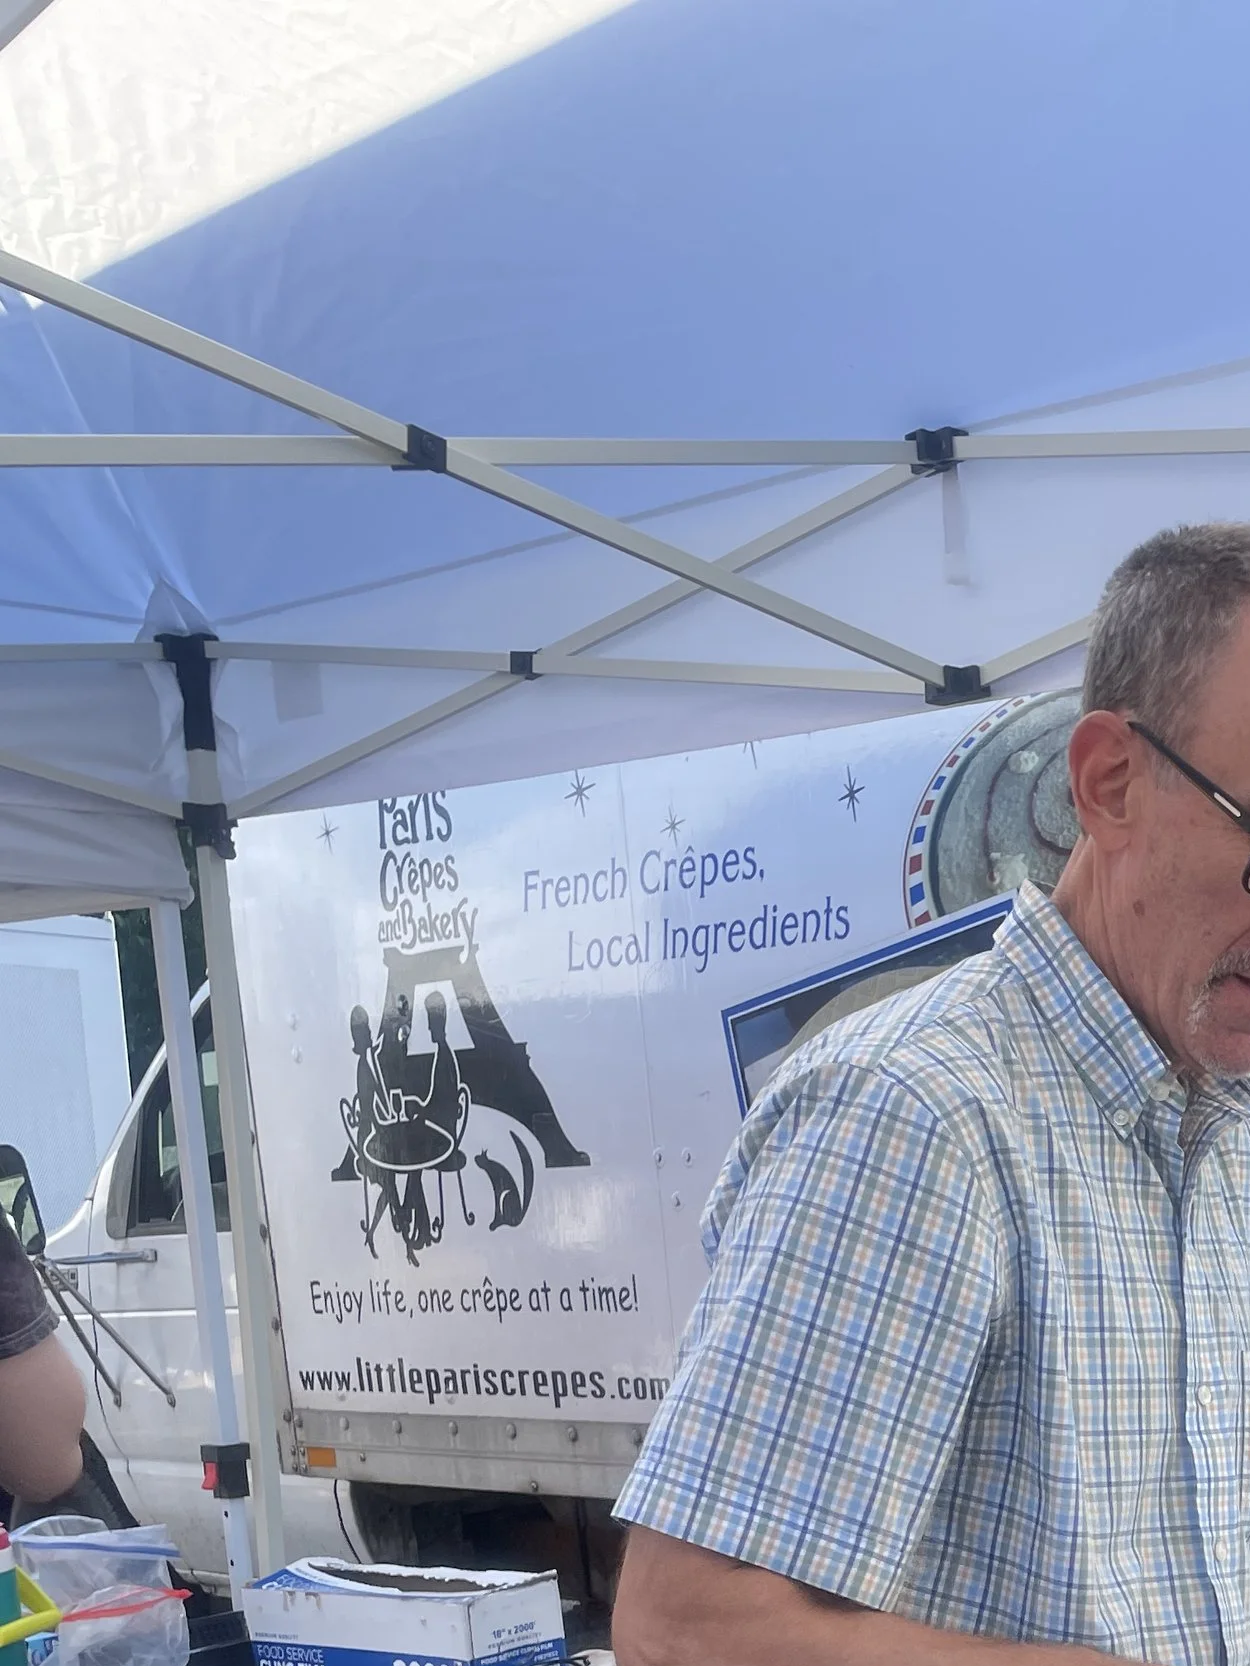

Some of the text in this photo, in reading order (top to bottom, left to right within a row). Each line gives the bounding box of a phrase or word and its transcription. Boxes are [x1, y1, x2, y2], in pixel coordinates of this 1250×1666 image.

[379, 850, 459, 912] Crêpes
[523, 845, 765, 913] French Crêpes,
[400, 897, 478, 964] Bakery
[568, 896, 851, 974] Local Ingredients
[310, 1274, 639, 1324] Enjoy life, one crêpe at a time!
[300, 1357, 671, 1408] www.littlepariscrepes.com
[257, 1644, 324, 1663] FOOD SERVICE
